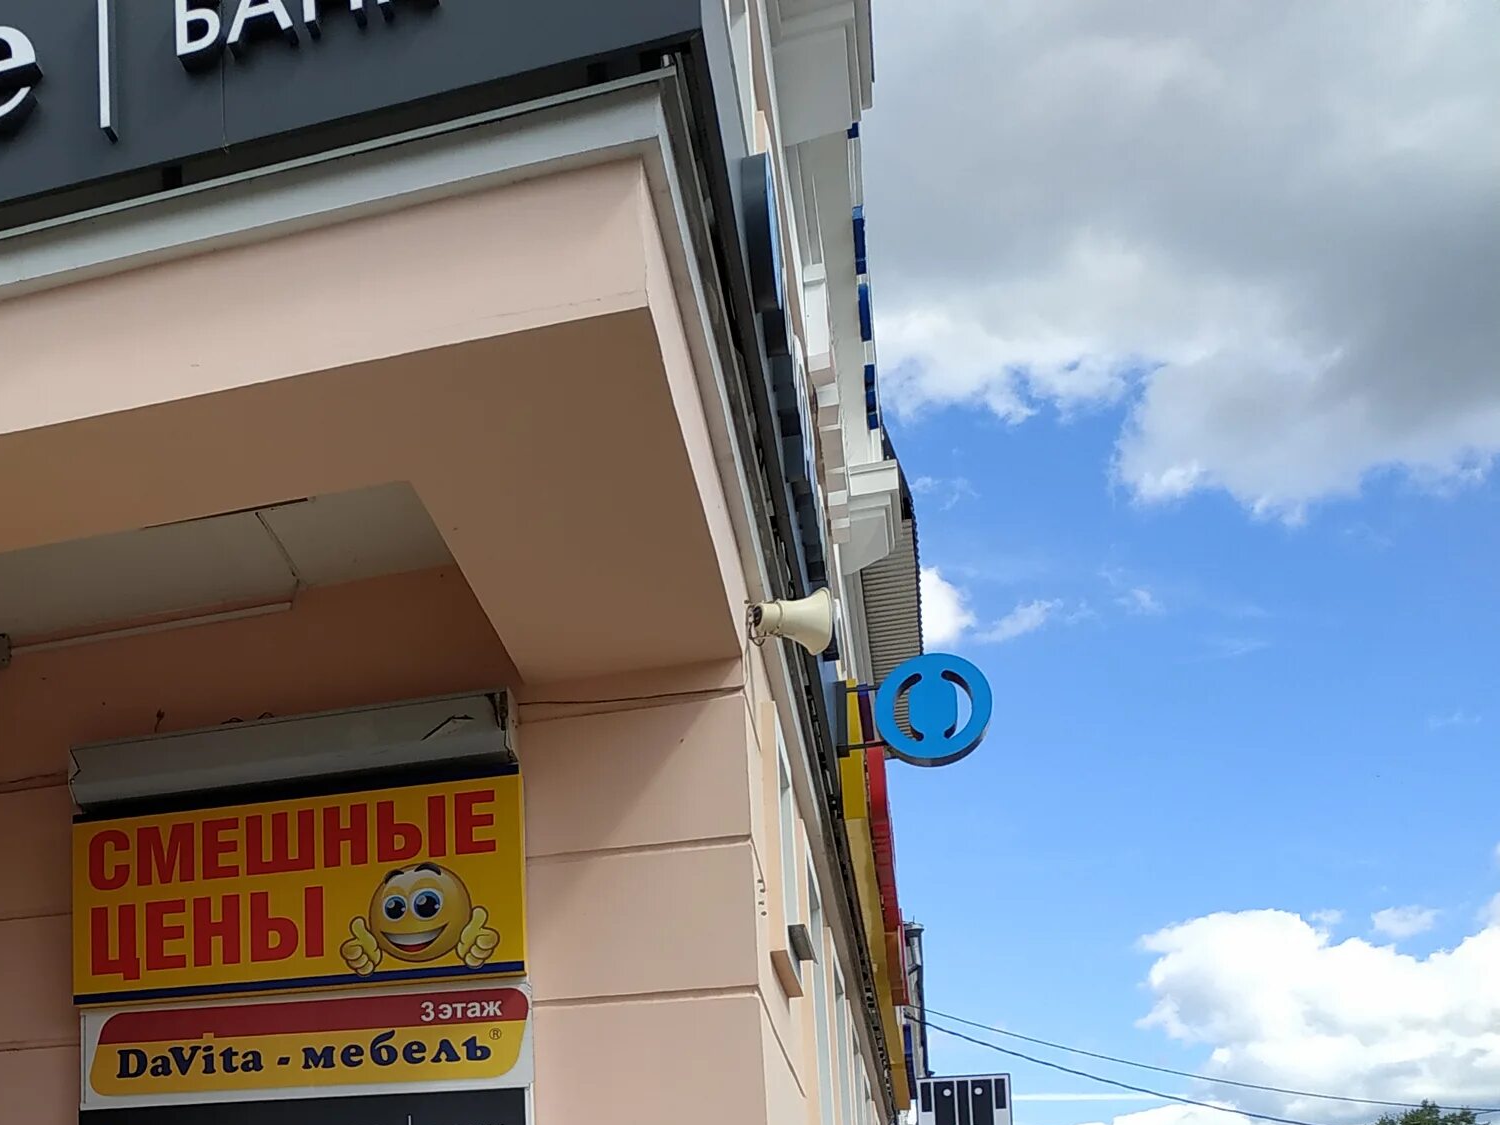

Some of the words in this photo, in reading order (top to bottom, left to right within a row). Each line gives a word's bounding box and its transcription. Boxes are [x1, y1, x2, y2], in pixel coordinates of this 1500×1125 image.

[88, 789, 497, 892] СМЕШНЫЕ
[90, 886, 325, 980] ЦЕНЫ
[115, 1044, 264, 1079] DaVita
